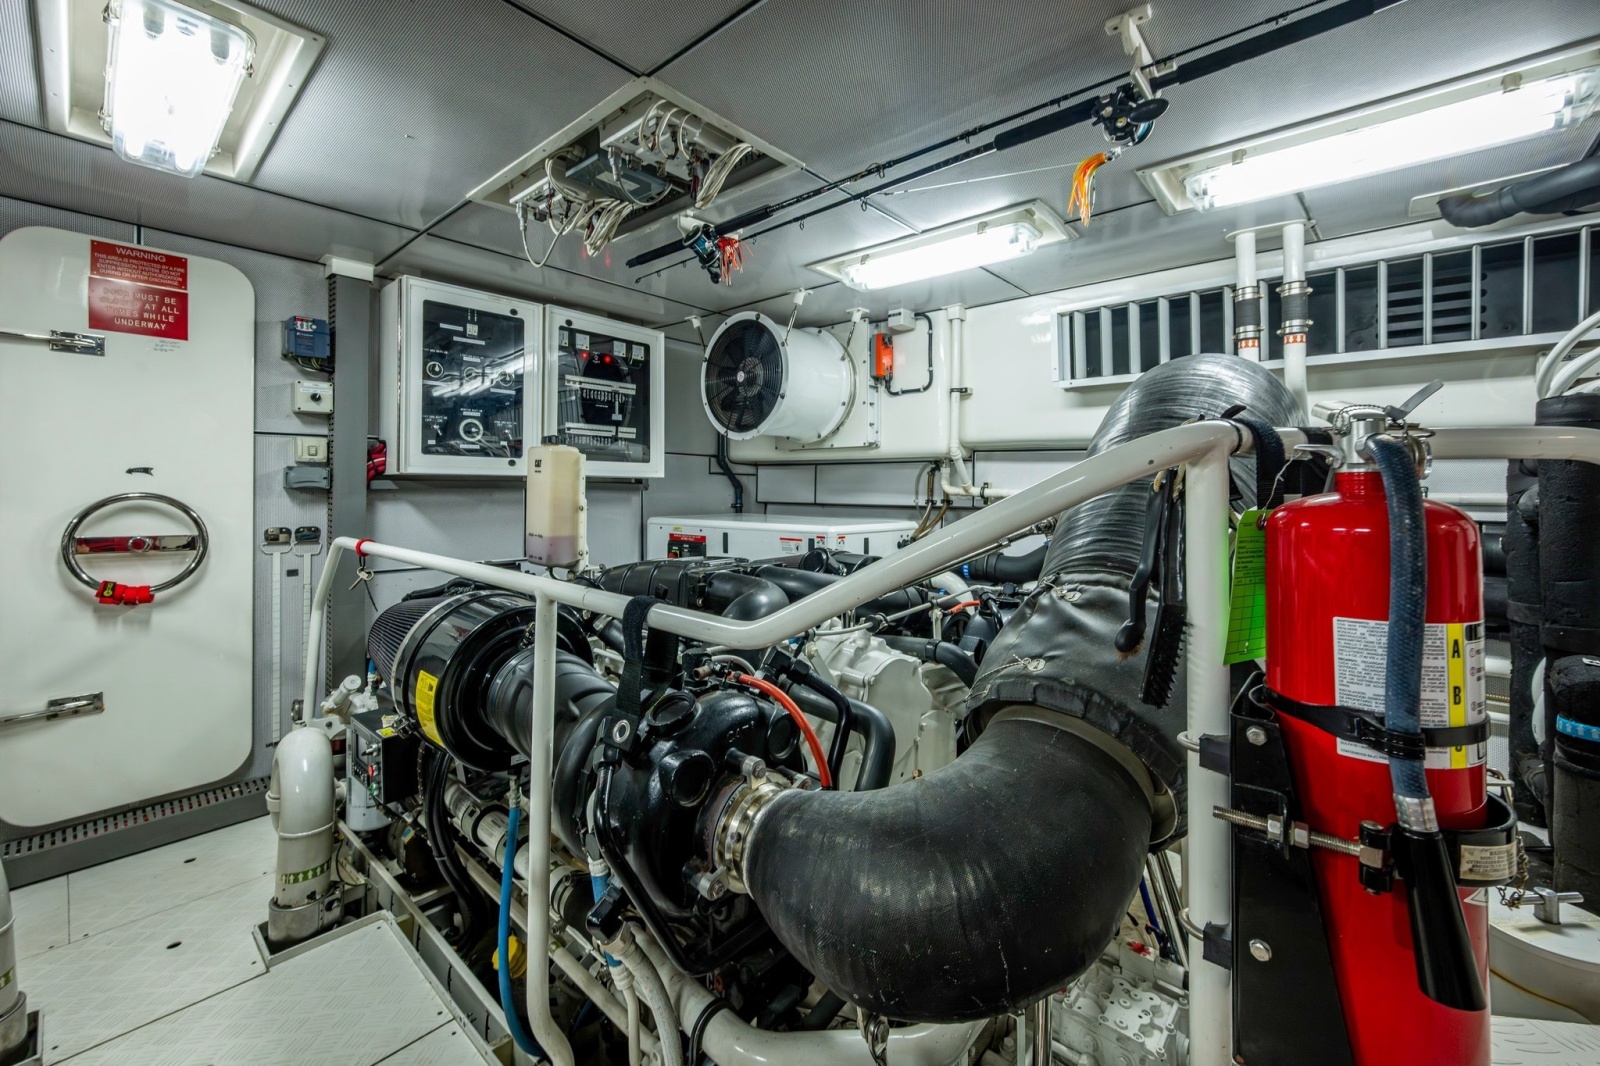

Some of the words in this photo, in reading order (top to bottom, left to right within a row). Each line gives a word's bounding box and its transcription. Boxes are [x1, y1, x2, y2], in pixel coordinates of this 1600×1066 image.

[116, 247, 166, 262] WARNING
[98, 259, 137, 269] SUPPRESSION
[129, 258, 161, 268] PROTECTED
[142, 270, 182, 282] AUTHORIZATION
[134, 292, 159, 302] MUST
[164, 297, 176, 305] BE
[106, 306, 138, 317] TIMES
[143, 312, 174, 322] WHILE
[162, 306, 179, 314] ALL
[115, 317, 166, 330] UNDERWAY
[1452, 639, 1460, 658] A
[1453, 686, 1461, 705] B
